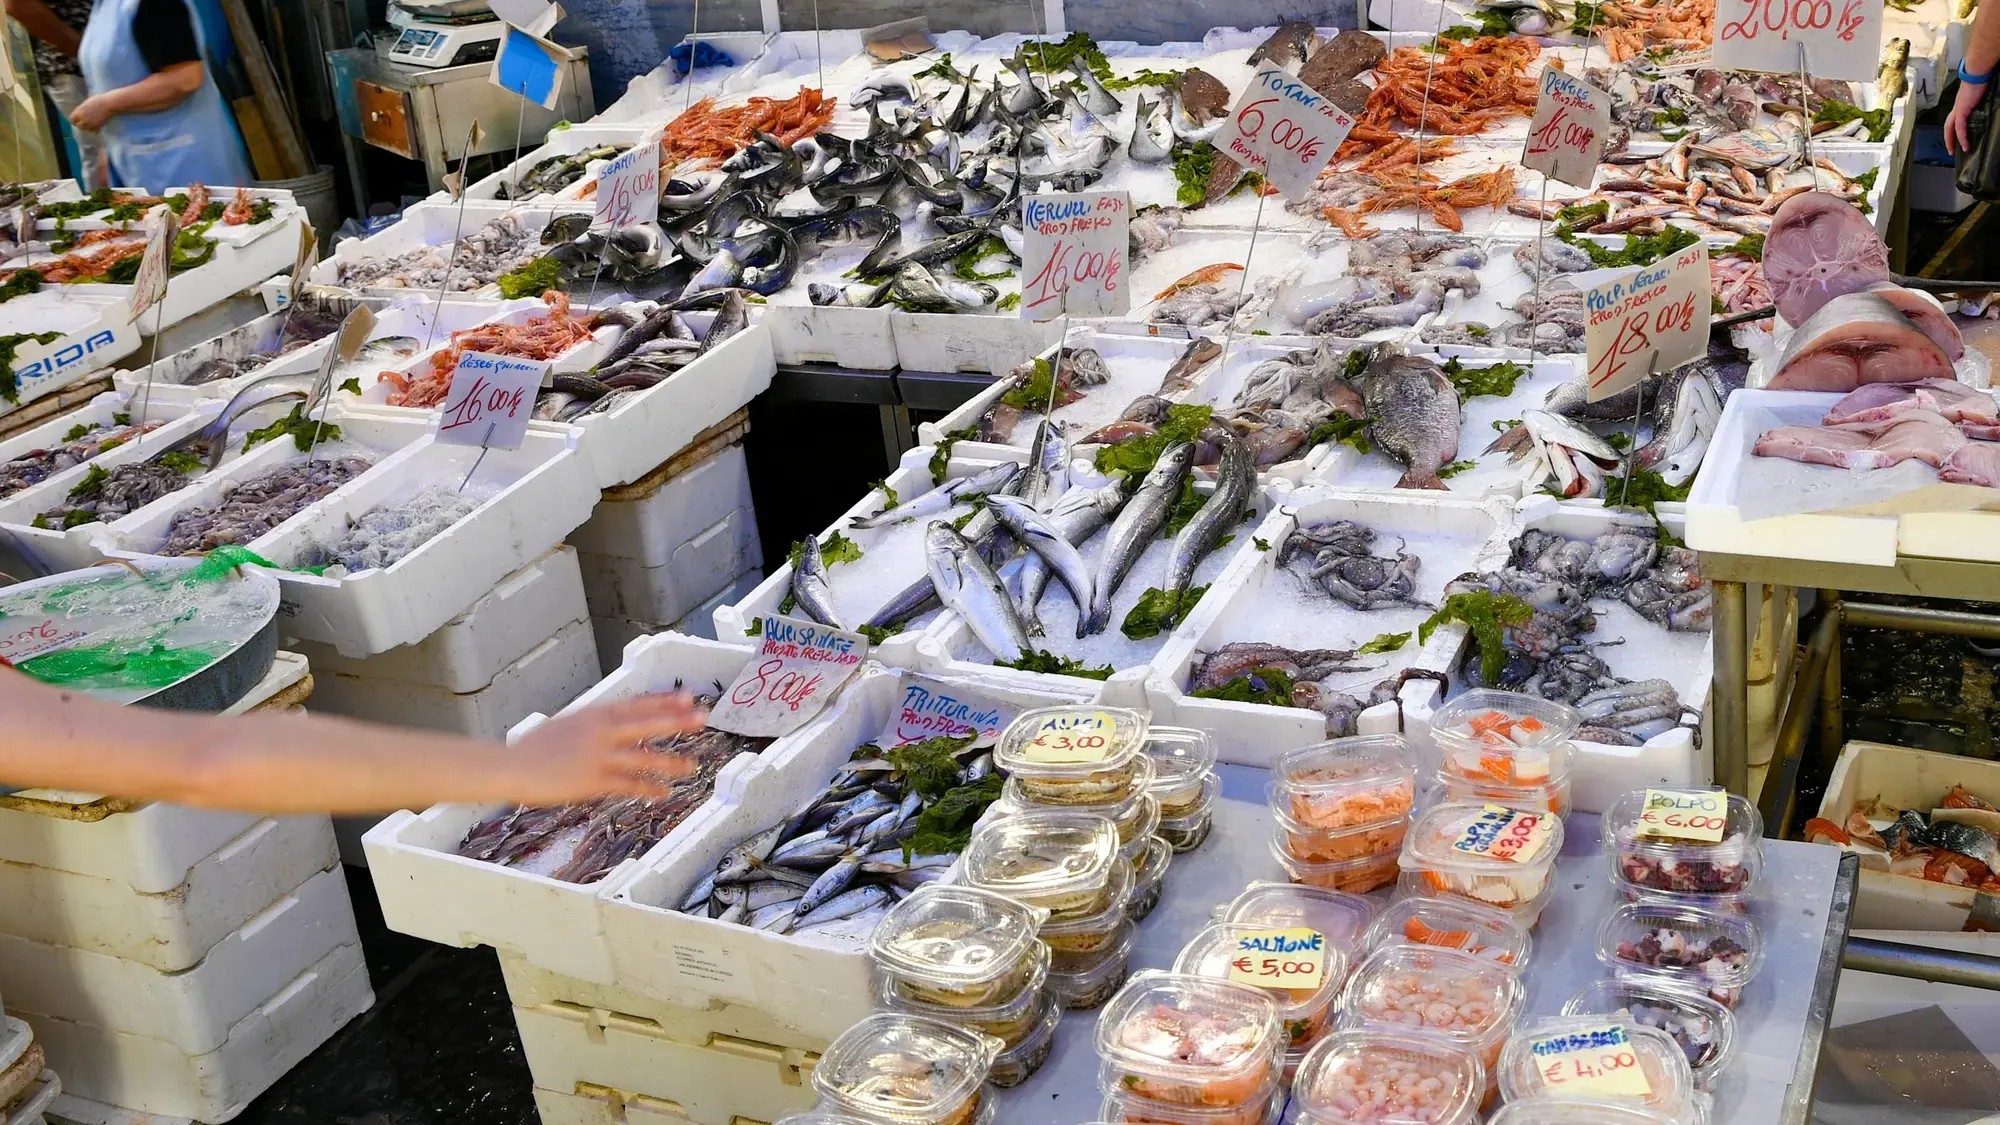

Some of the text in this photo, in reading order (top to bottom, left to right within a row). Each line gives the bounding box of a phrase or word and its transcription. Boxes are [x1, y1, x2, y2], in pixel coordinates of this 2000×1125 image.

[14, 329, 116, 388] RIDA
[1041, 718, 1104, 732] ALICI
[1051, 735, 1106, 752] 3,00
[1650, 792, 1718, 812] POLPO
[1238, 933, 1323, 953] SALMONE
[1258, 958, 1316, 978] 5,00
[1574, 1051, 1637, 1078] 4,00
